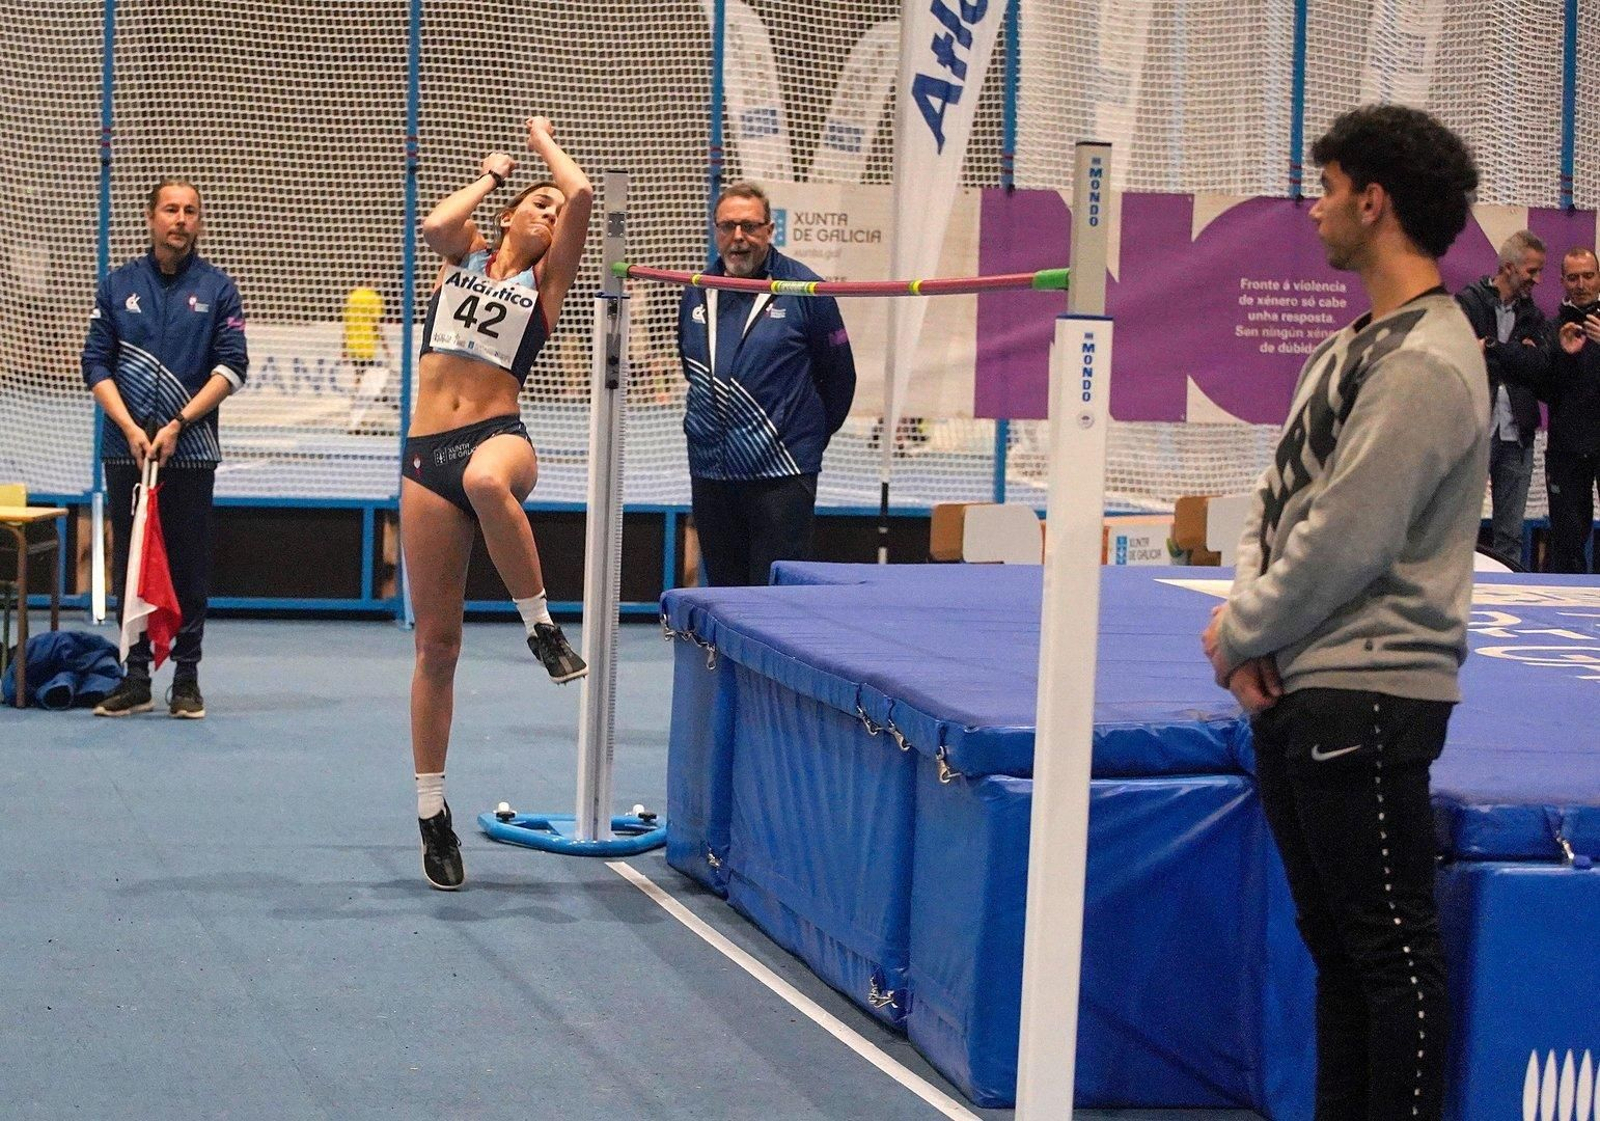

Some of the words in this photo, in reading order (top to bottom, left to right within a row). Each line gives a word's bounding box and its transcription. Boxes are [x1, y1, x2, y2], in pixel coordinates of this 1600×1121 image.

[1089, 167, 1103, 227] MONDO
[794, 212, 848, 226] XUNTA
[793, 228, 813, 242] DE
[816, 229, 882, 243] GALICIA
[445, 271, 533, 308] Atlántico
[1240, 278, 1281, 291] Fronte
[1292, 280, 1347, 293] violencia
[1257, 295, 1299, 307] xénero
[1301, 295, 1316, 308] só
[1318, 297, 1347, 308] cabe
[453, 295, 508, 340] 42
[1247, 311, 1279, 322] unha
[1281, 312, 1336, 325] resposta.
[1259, 342, 1275, 354] de
[1082, 342, 1095, 402] MONDO
[447, 443, 471, 454] XUNTA
[448, 452, 458, 461] DE
